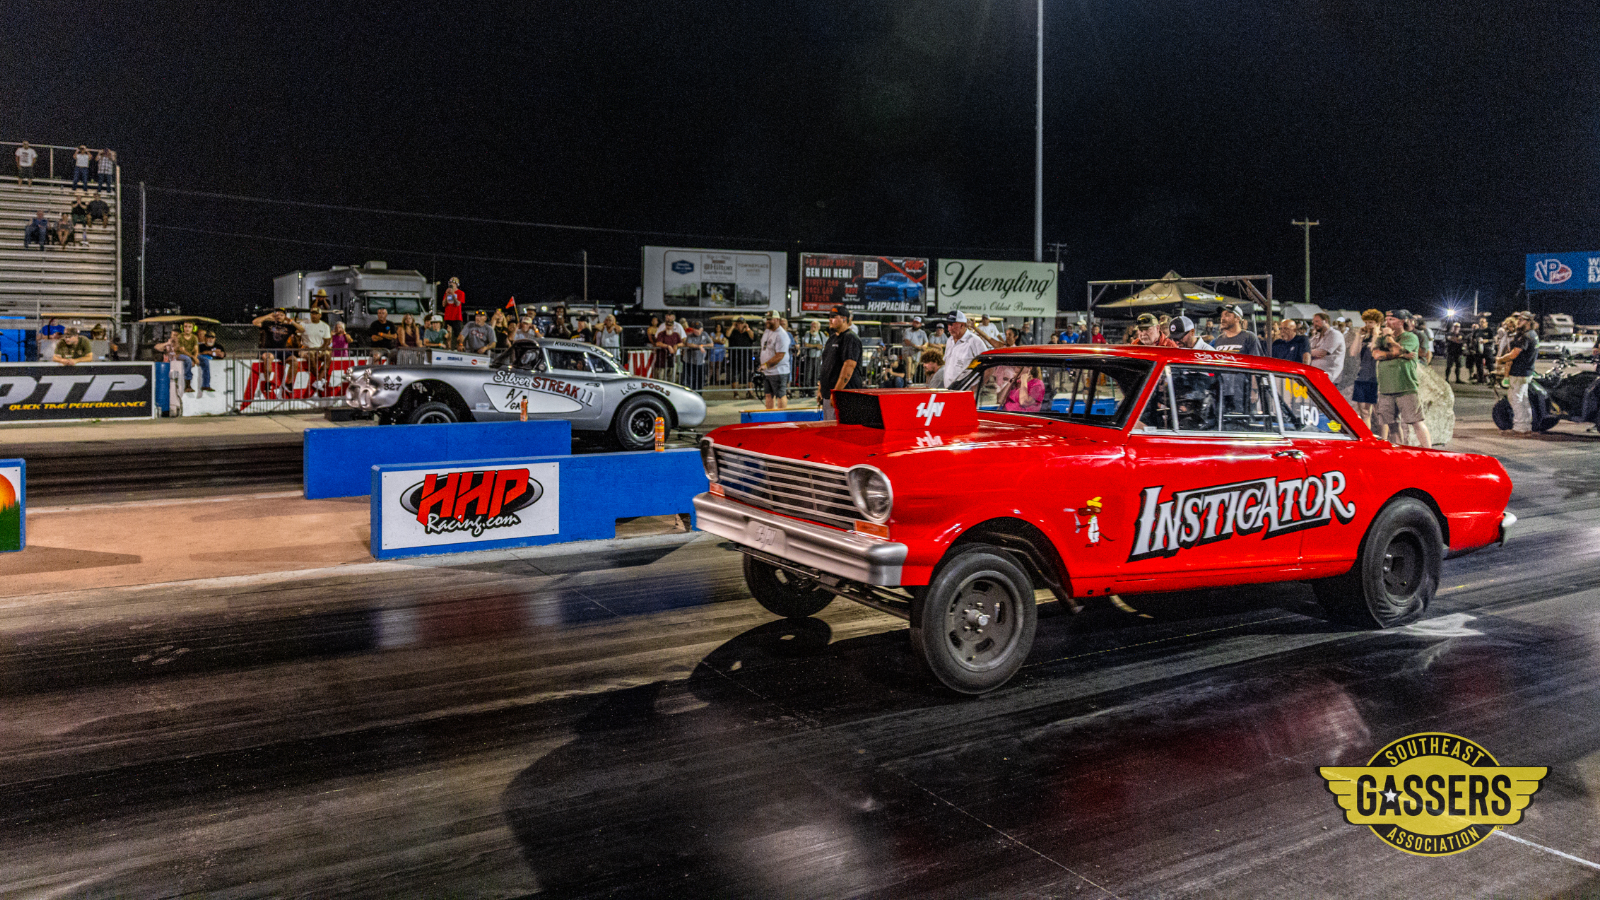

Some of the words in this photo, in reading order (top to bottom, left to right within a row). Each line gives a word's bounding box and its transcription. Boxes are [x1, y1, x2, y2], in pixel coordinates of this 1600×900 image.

[805, 267, 820, 277] GEN
[833, 268, 852, 278] HEMI
[940, 261, 1055, 300] Yuengling
[949, 301, 987, 312] America's
[989, 301, 1011, 311] Oldest
[1013, 302, 1045, 314] Brewery
[383, 383, 402, 391] 327
[493, 370, 531, 388] Silver
[531, 376, 581, 400] STREAK
[641, 382, 671, 396] POOLS
[9, 402, 41, 411] QUICK
[44, 402, 67, 410] TIME
[68, 401, 147, 409] PERFORMANCE
[1300, 405, 1319, 427] 150
[416, 468, 530, 526] HHP
[425, 512, 521, 537] Racing.com
